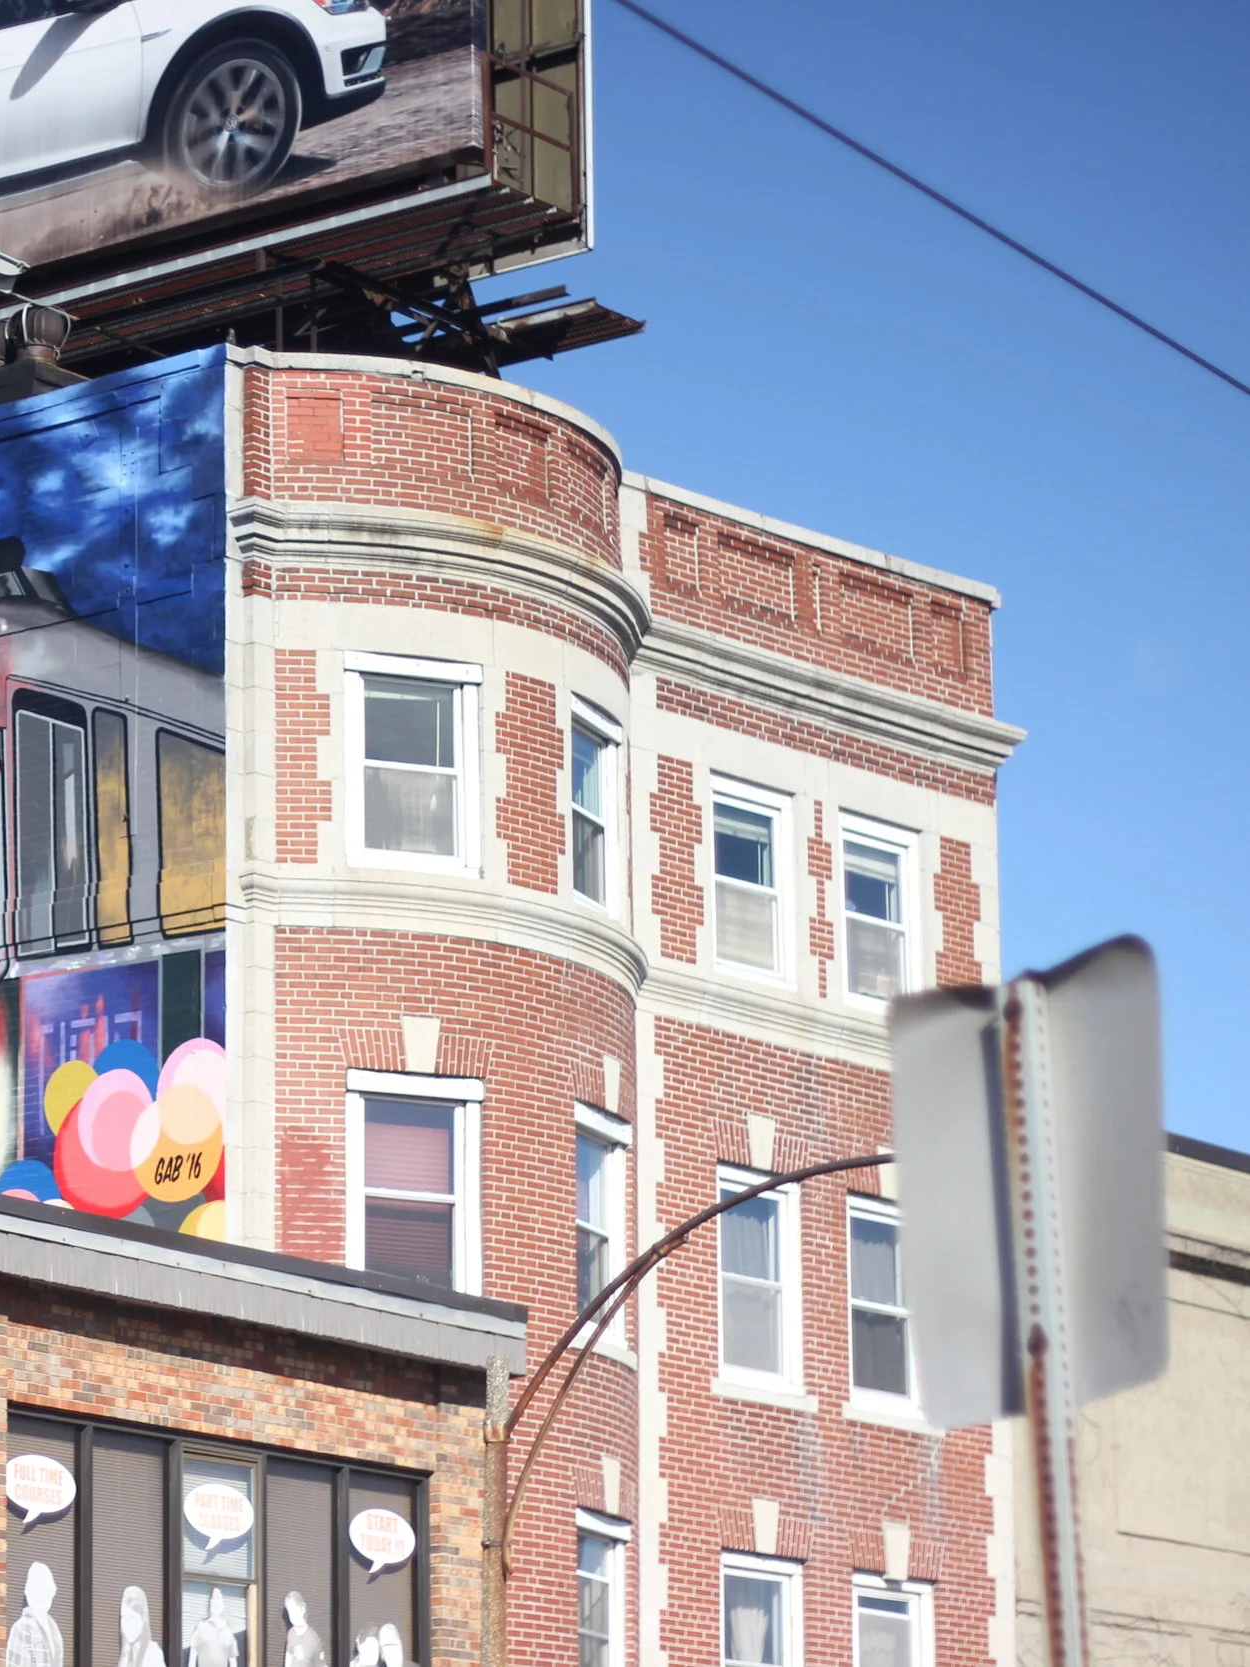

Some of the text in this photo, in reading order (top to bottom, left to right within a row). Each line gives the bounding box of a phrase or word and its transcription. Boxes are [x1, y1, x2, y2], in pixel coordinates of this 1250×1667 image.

[154, 1151, 203, 1185] GAB '16
[14, 1464, 62, 1486] FULL TIME
[15, 1484, 62, 1506] COURSES
[195, 1492, 243, 1513] PART TIME
[198, 1512, 239, 1532] CLASSES
[367, 1513, 397, 1533] START
